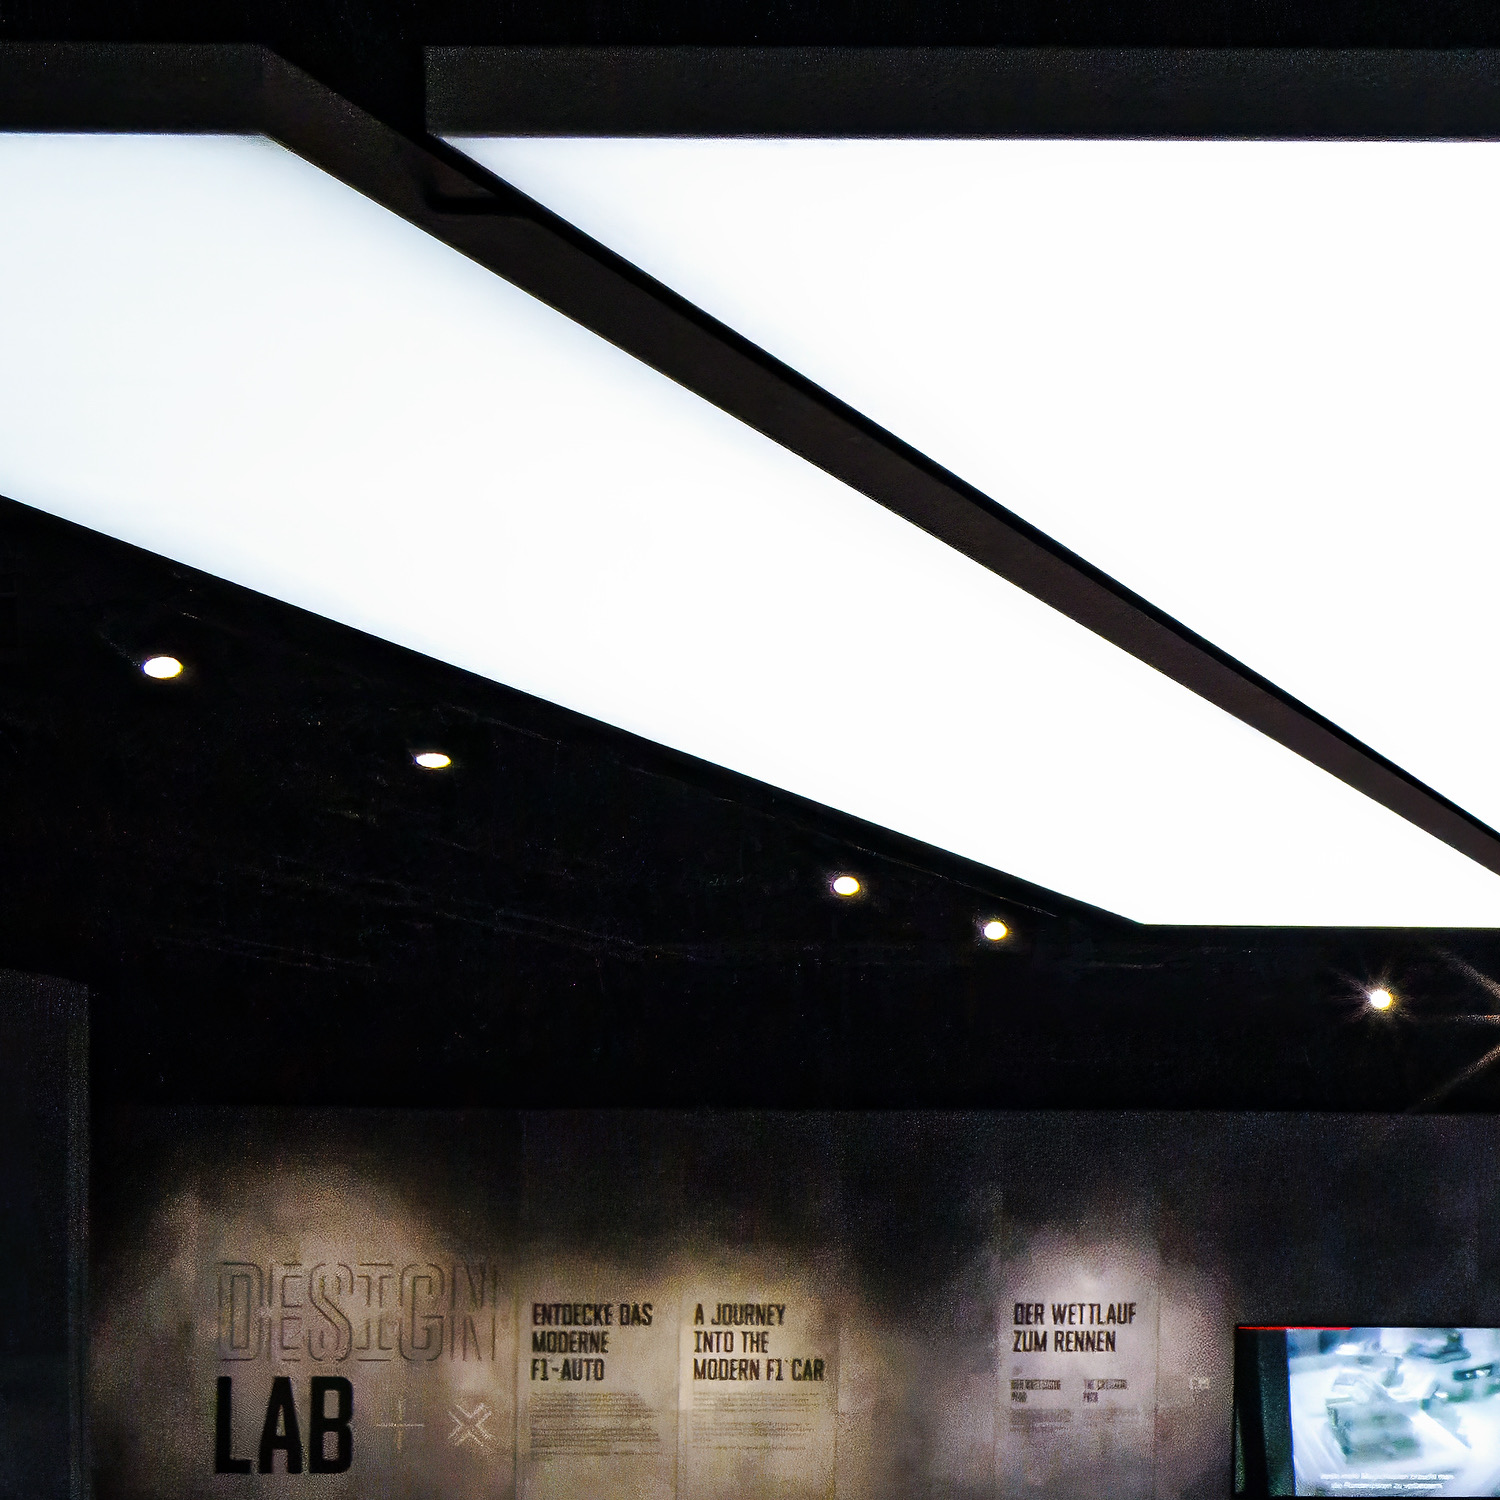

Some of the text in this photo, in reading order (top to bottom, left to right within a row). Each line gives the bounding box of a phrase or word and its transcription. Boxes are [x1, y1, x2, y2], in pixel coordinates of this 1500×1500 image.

[218, 1261, 497, 1361] DESIGN
[532, 1303, 653, 1326] ENTDECKE DAS
[694, 1303, 785, 1326] A JOURNEY
[1013, 1302, 1136, 1325] DER WETTLAUF
[531, 1330, 609, 1353] MODERNE
[694, 1330, 769, 1353] INTO THE
[1012, 1330, 1116, 1352] ZUM RENNEN
[530, 1357, 605, 1381] F1-AUTO
[693, 1357, 825, 1381] MODERN F1 CAR
[215, 1376, 353, 1474] LAB
